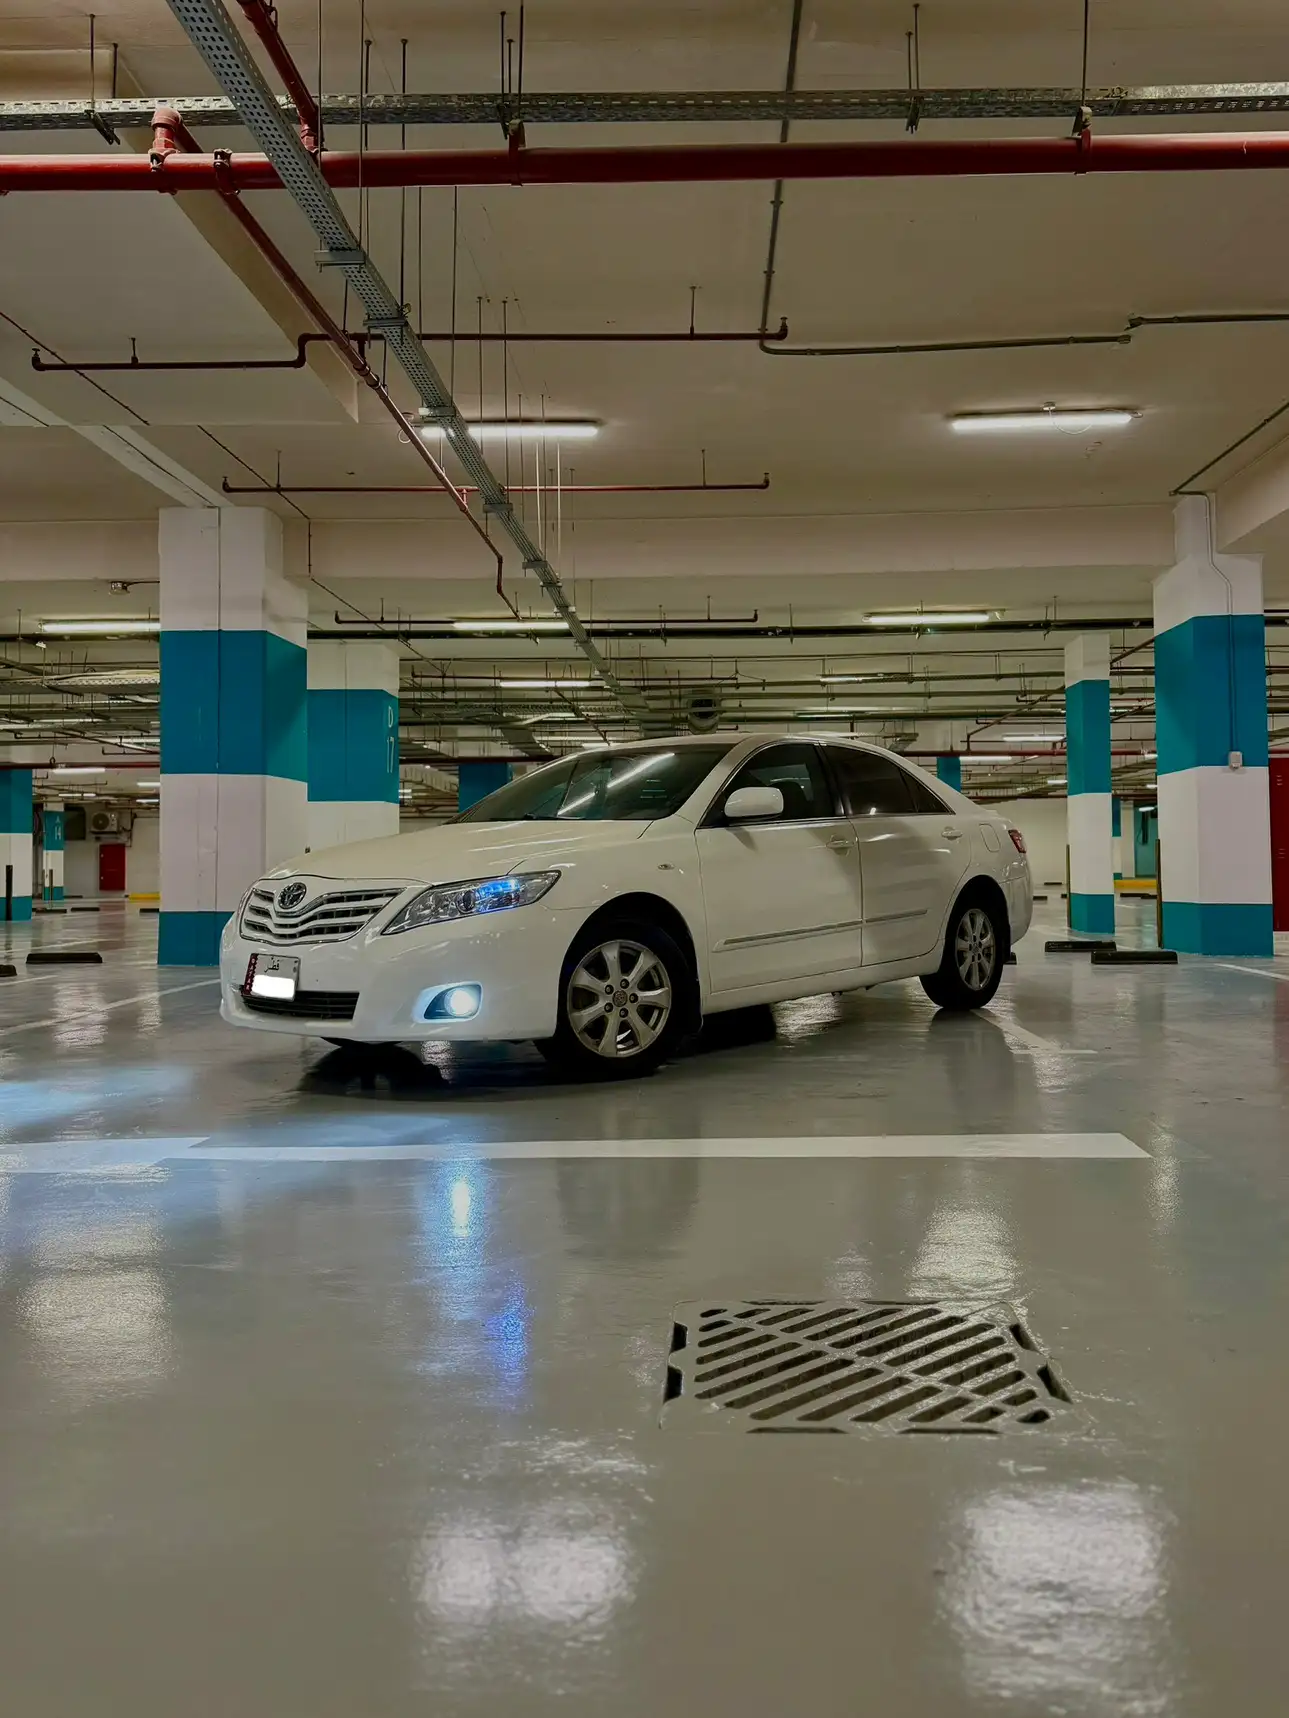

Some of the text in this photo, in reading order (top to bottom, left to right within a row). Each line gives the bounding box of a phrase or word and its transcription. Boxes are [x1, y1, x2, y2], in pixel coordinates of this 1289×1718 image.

[388, 705, 394, 728] D
[386, 736, 395, 773] 17
[245, 958, 256, 990] QATAR
[264, 957, 280, 973] قطر
